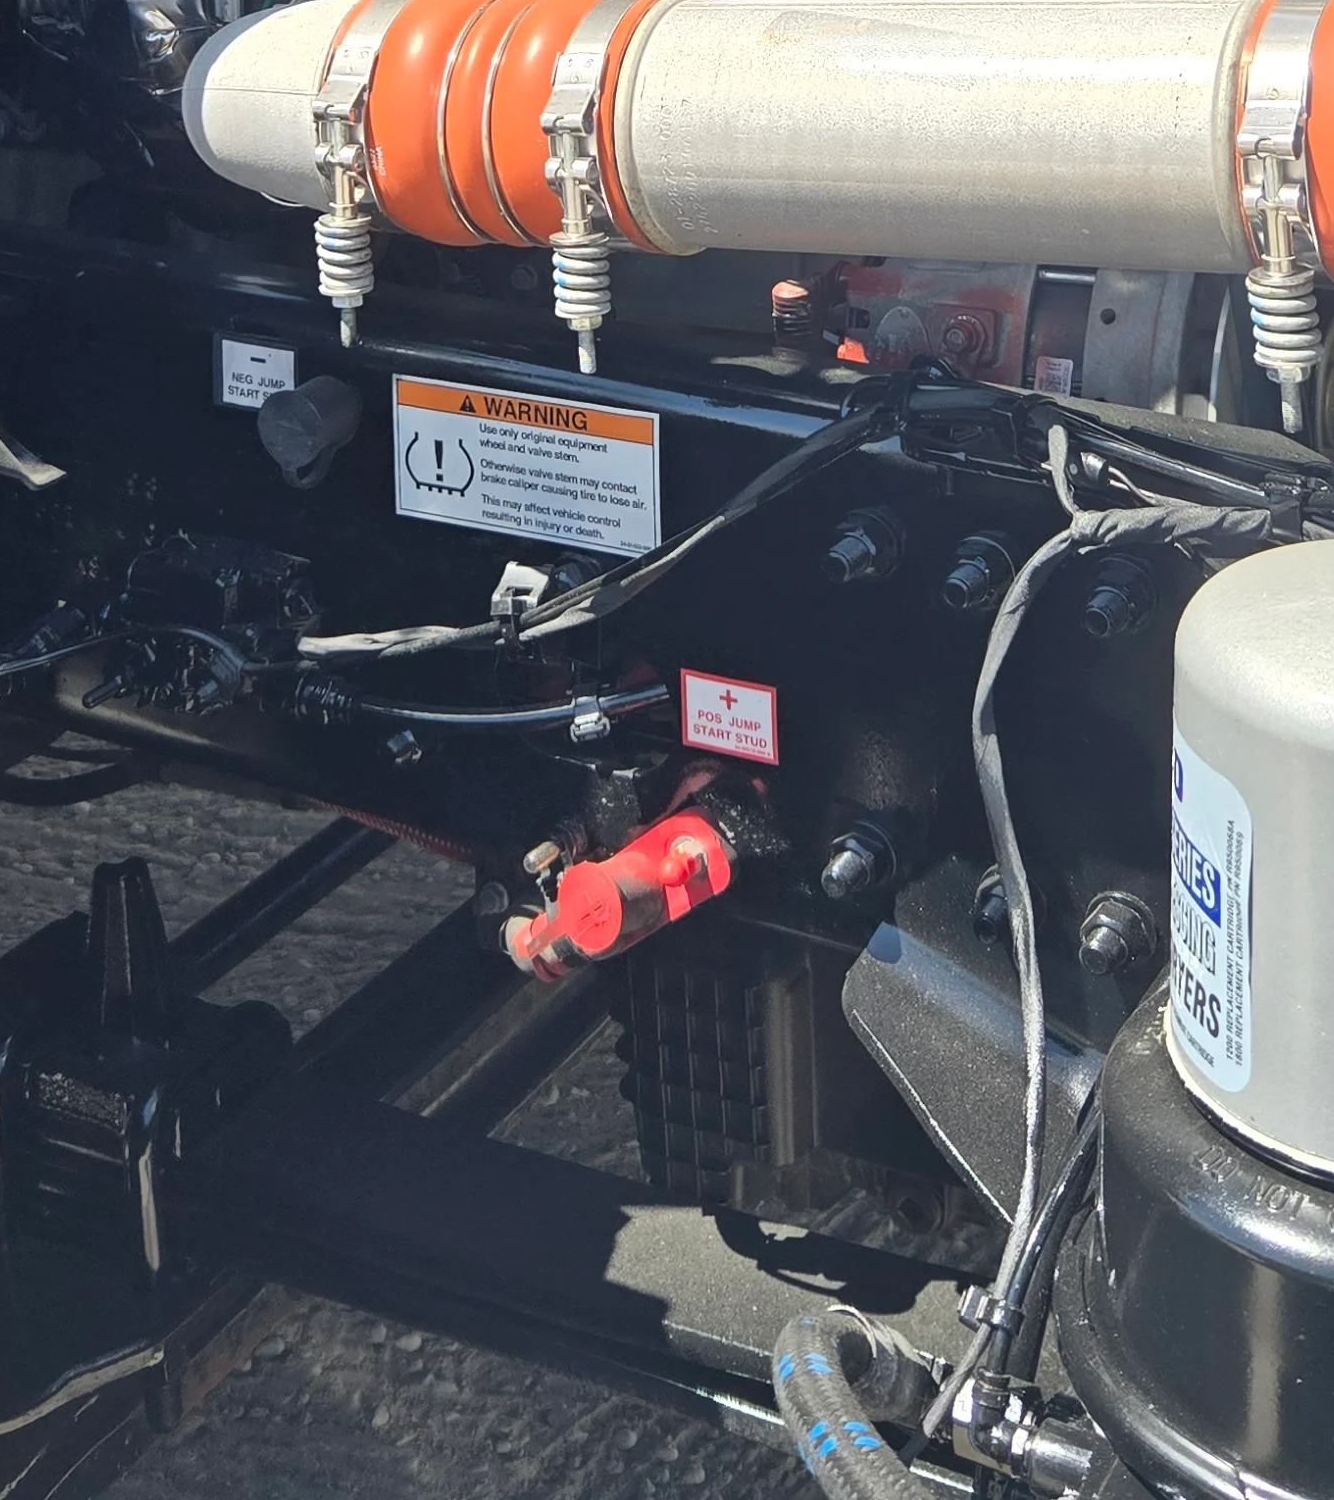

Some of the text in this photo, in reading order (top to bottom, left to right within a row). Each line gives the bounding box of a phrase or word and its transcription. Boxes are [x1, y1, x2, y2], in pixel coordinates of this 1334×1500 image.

[227, 385, 260, 400] START
[232, 372, 286, 390] NEG JUMP
[483, 396, 589, 432] WARNING
[479, 422, 608, 453] Use only original equipment
[479, 438, 580, 464] wheel and valve stem.
[480, 458, 638, 495] Otherwise valve stem may contact
[480, 471, 648, 511] brake caliper causing tire to lose air.
[481, 493, 621, 528] This may affect vehicle control
[482, 509, 605, 540] resulting in injury or death.
[693, 723, 767, 749] START STUD
[697, 709, 761, 732] POS JUMP
[1172, 822, 1216, 910] ERIES
[1171, 943, 1222, 1039] RYERS
[1225, 955, 1235, 1034] REPLACEMENT
[1234, 961, 1244, 1039] REPLACEMENT
[1225, 1035, 1235, 1061] 1200
[1234, 1041, 1243, 1067] 1800
[1194, 1144, 1239, 1184] DO
[1245, 1175, 1312, 1220] NOT
